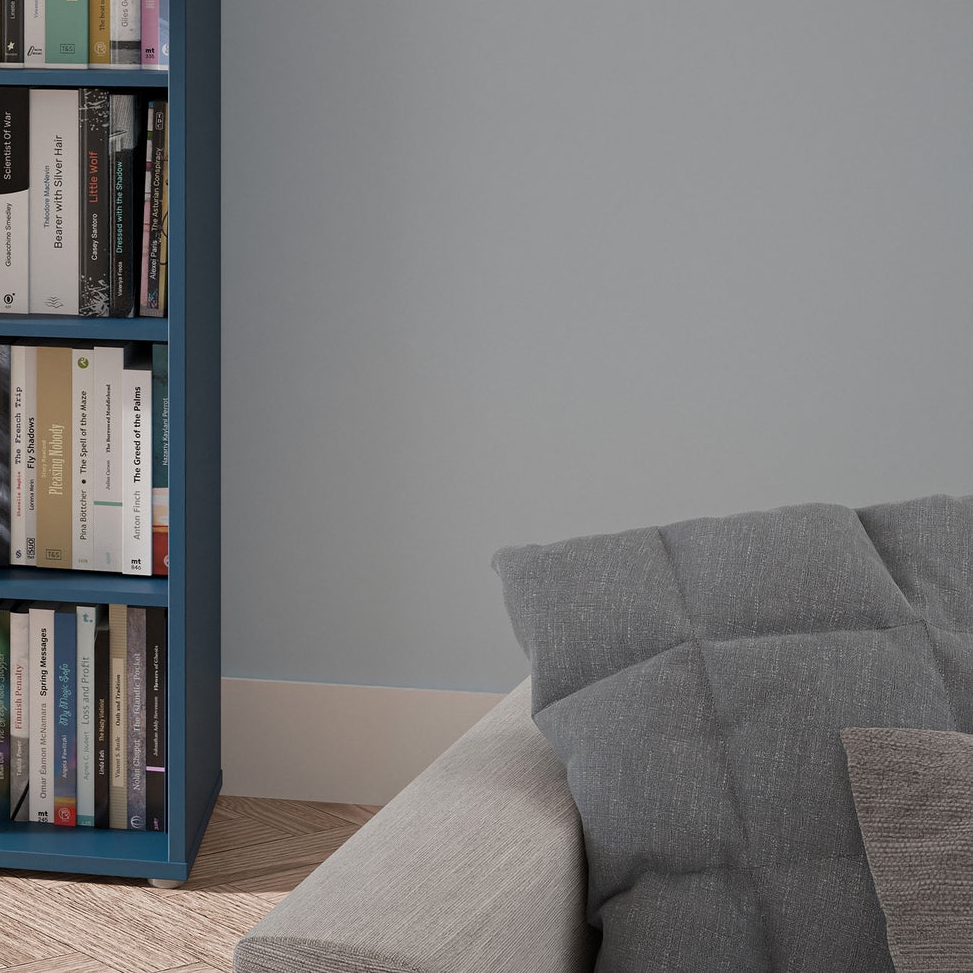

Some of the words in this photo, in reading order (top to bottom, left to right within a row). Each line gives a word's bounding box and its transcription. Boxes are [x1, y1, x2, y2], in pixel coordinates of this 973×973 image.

[3, 112, 12, 128] War
[3, 129, 12, 140] Of
[54, 135, 63, 156] Hair
[3, 141, 12, 180] Scientist
[54, 159, 63, 187] Silver
[89, 152, 98, 173] Wolf
[153, 148, 162, 186] Conspiracy
[54, 189, 63, 212] with
[89, 177, 98, 202] Little
[152, 188, 160, 218] Asturian
[54, 215, 63, 249] Bearer
[49, 425, 65, 456] Nobody
[80, 428, 87, 436] of
[134, 430, 141, 439] of
[80, 438, 88, 457] Spell
[27, 456, 36, 469] Fly
[49, 458, 65, 495] Pleasing
[79, 491, 87, 522] Böttcher
[133, 490, 141, 513] Finch
[79, 524, 87, 540] Pina
[133, 515, 141, 540] Anton
[40, 628, 48, 667] Messages
[14, 665, 24, 696] Penalty
[40, 670, 48, 696] Spring
[81, 657, 89, 684] Profit
[81, 686, 89, 702] and
[14, 698, 22, 729] Finnish
[81, 706, 89, 725] Loss
